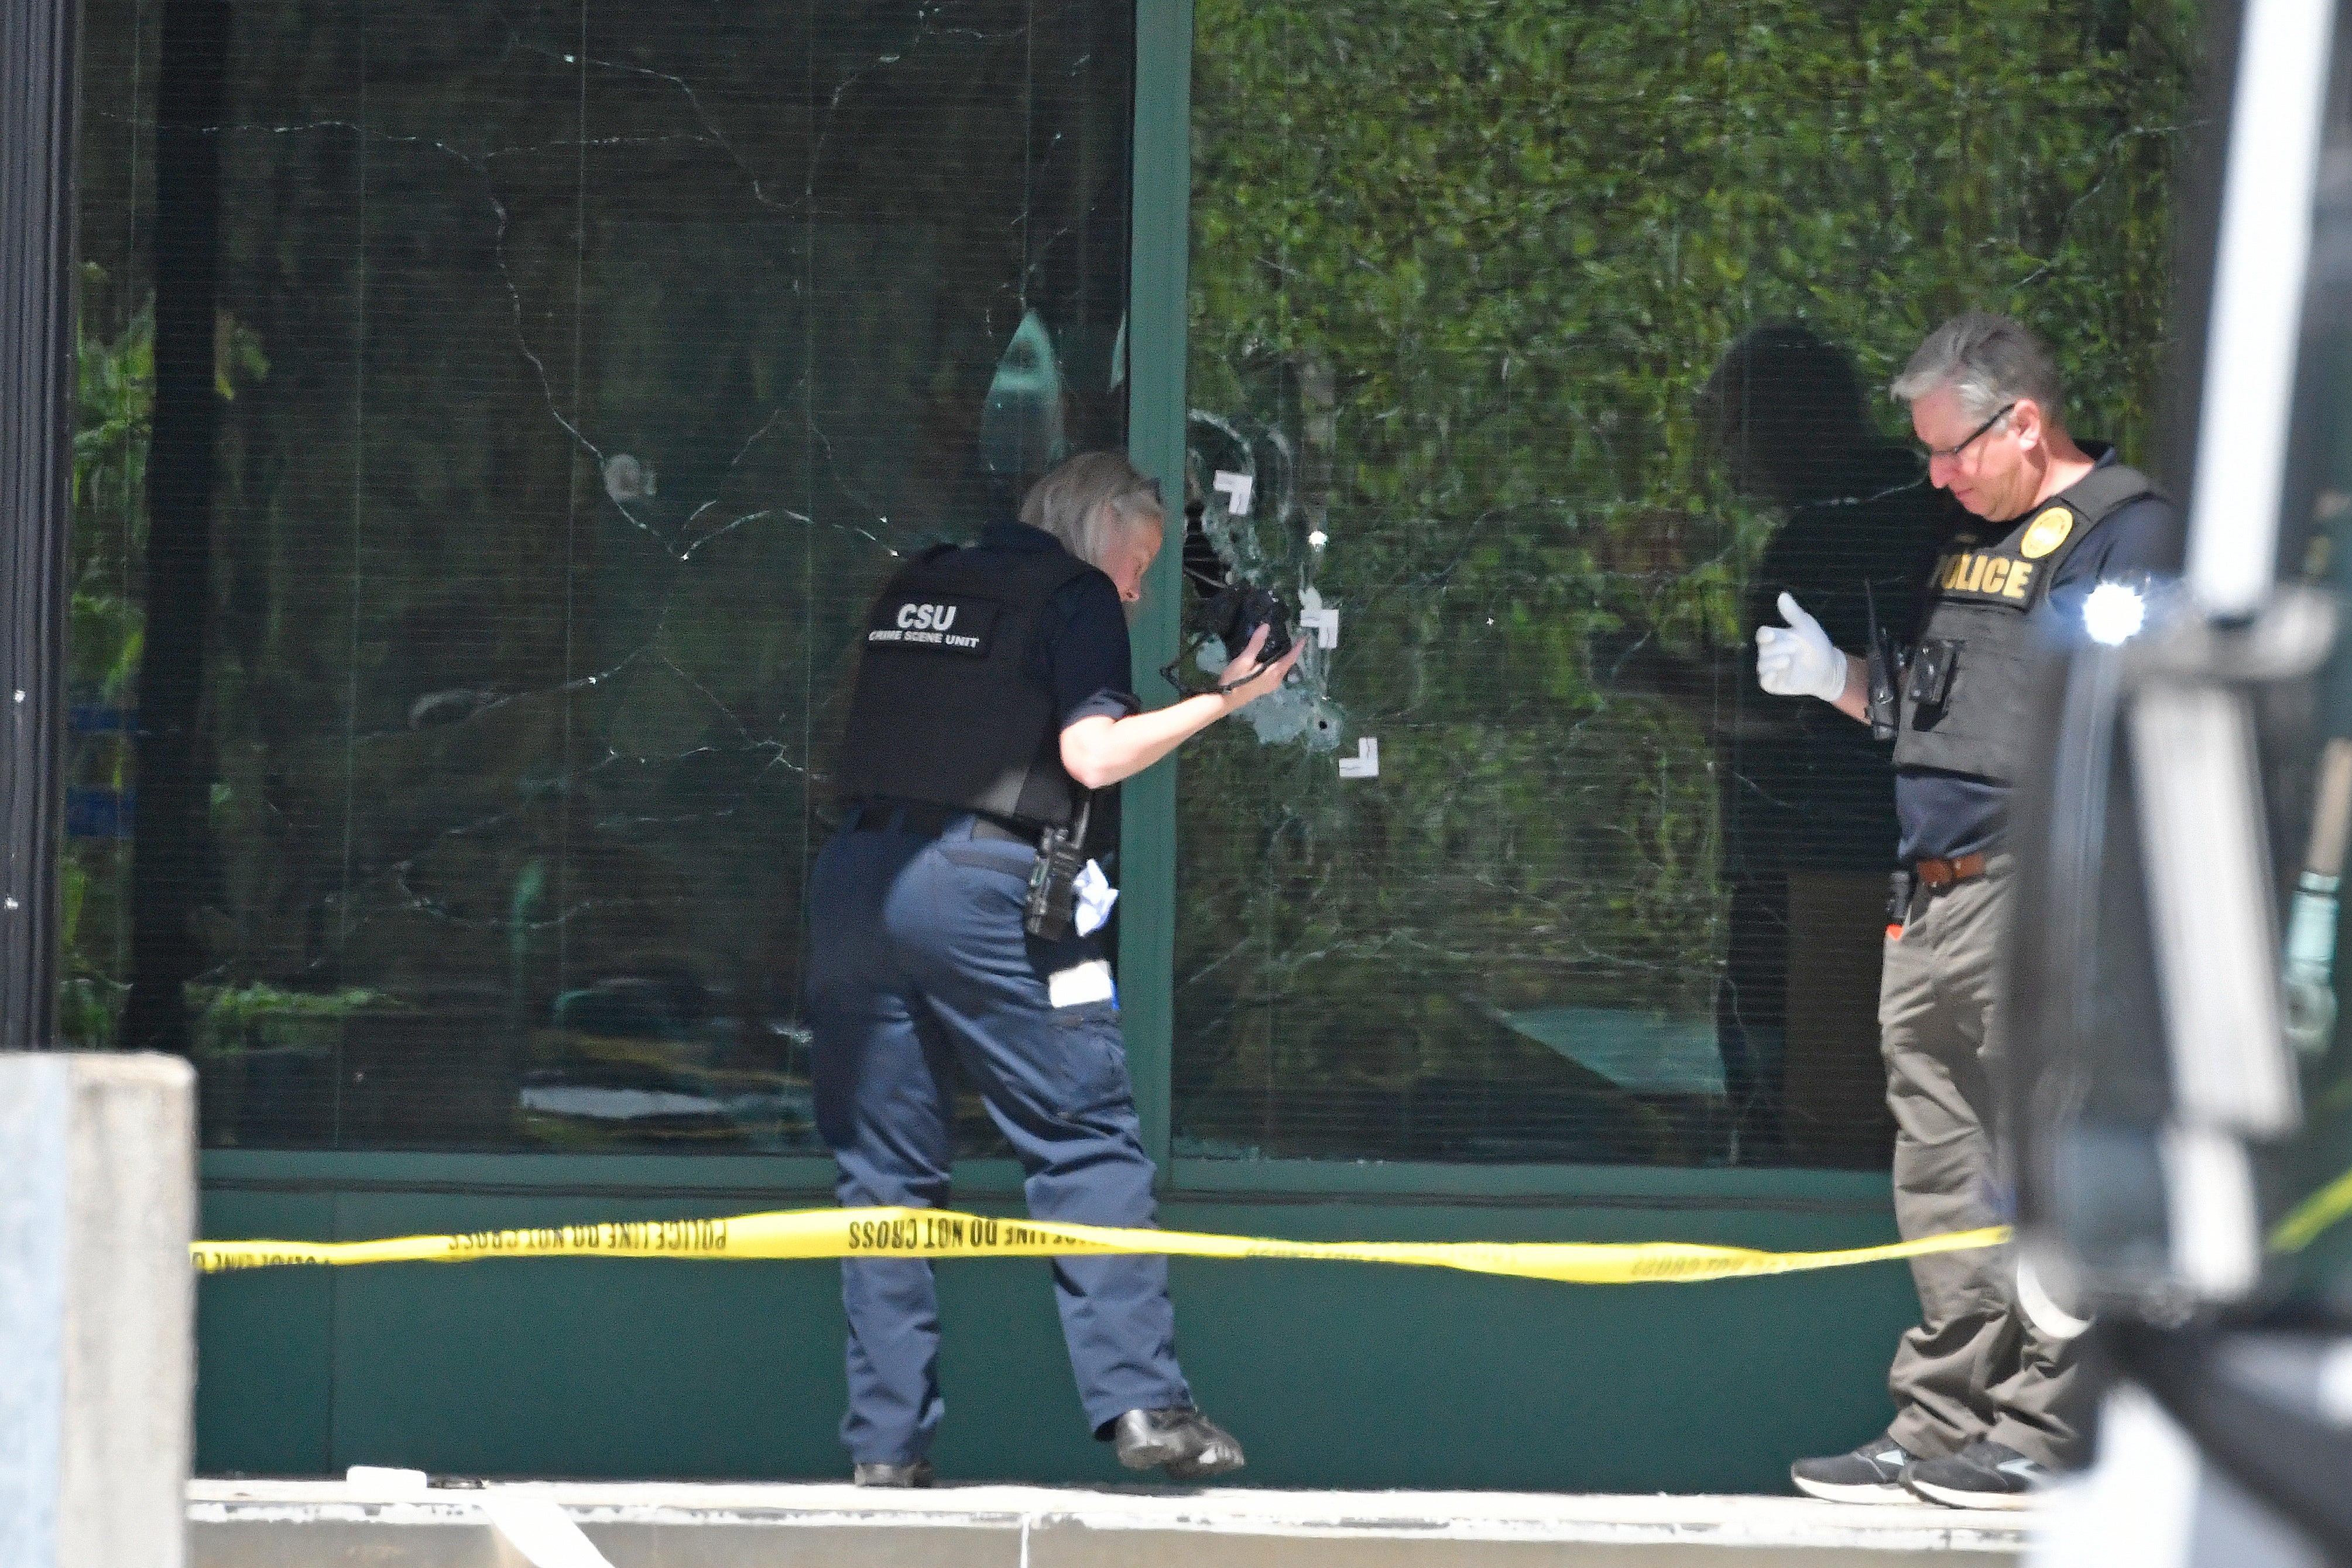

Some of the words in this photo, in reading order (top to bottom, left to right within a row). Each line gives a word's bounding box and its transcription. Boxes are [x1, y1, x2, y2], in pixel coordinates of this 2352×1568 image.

[897, 603, 956, 631] CSU
[869, 630, 903, 641] CRIME
[904, 630, 944, 644] SCENE
[945, 634, 980, 649] UNIT
[848, 1217, 917, 1250] CROSS
[924, 1217, 963, 1248] NOT
[970, 1219, 997, 1247] DO
